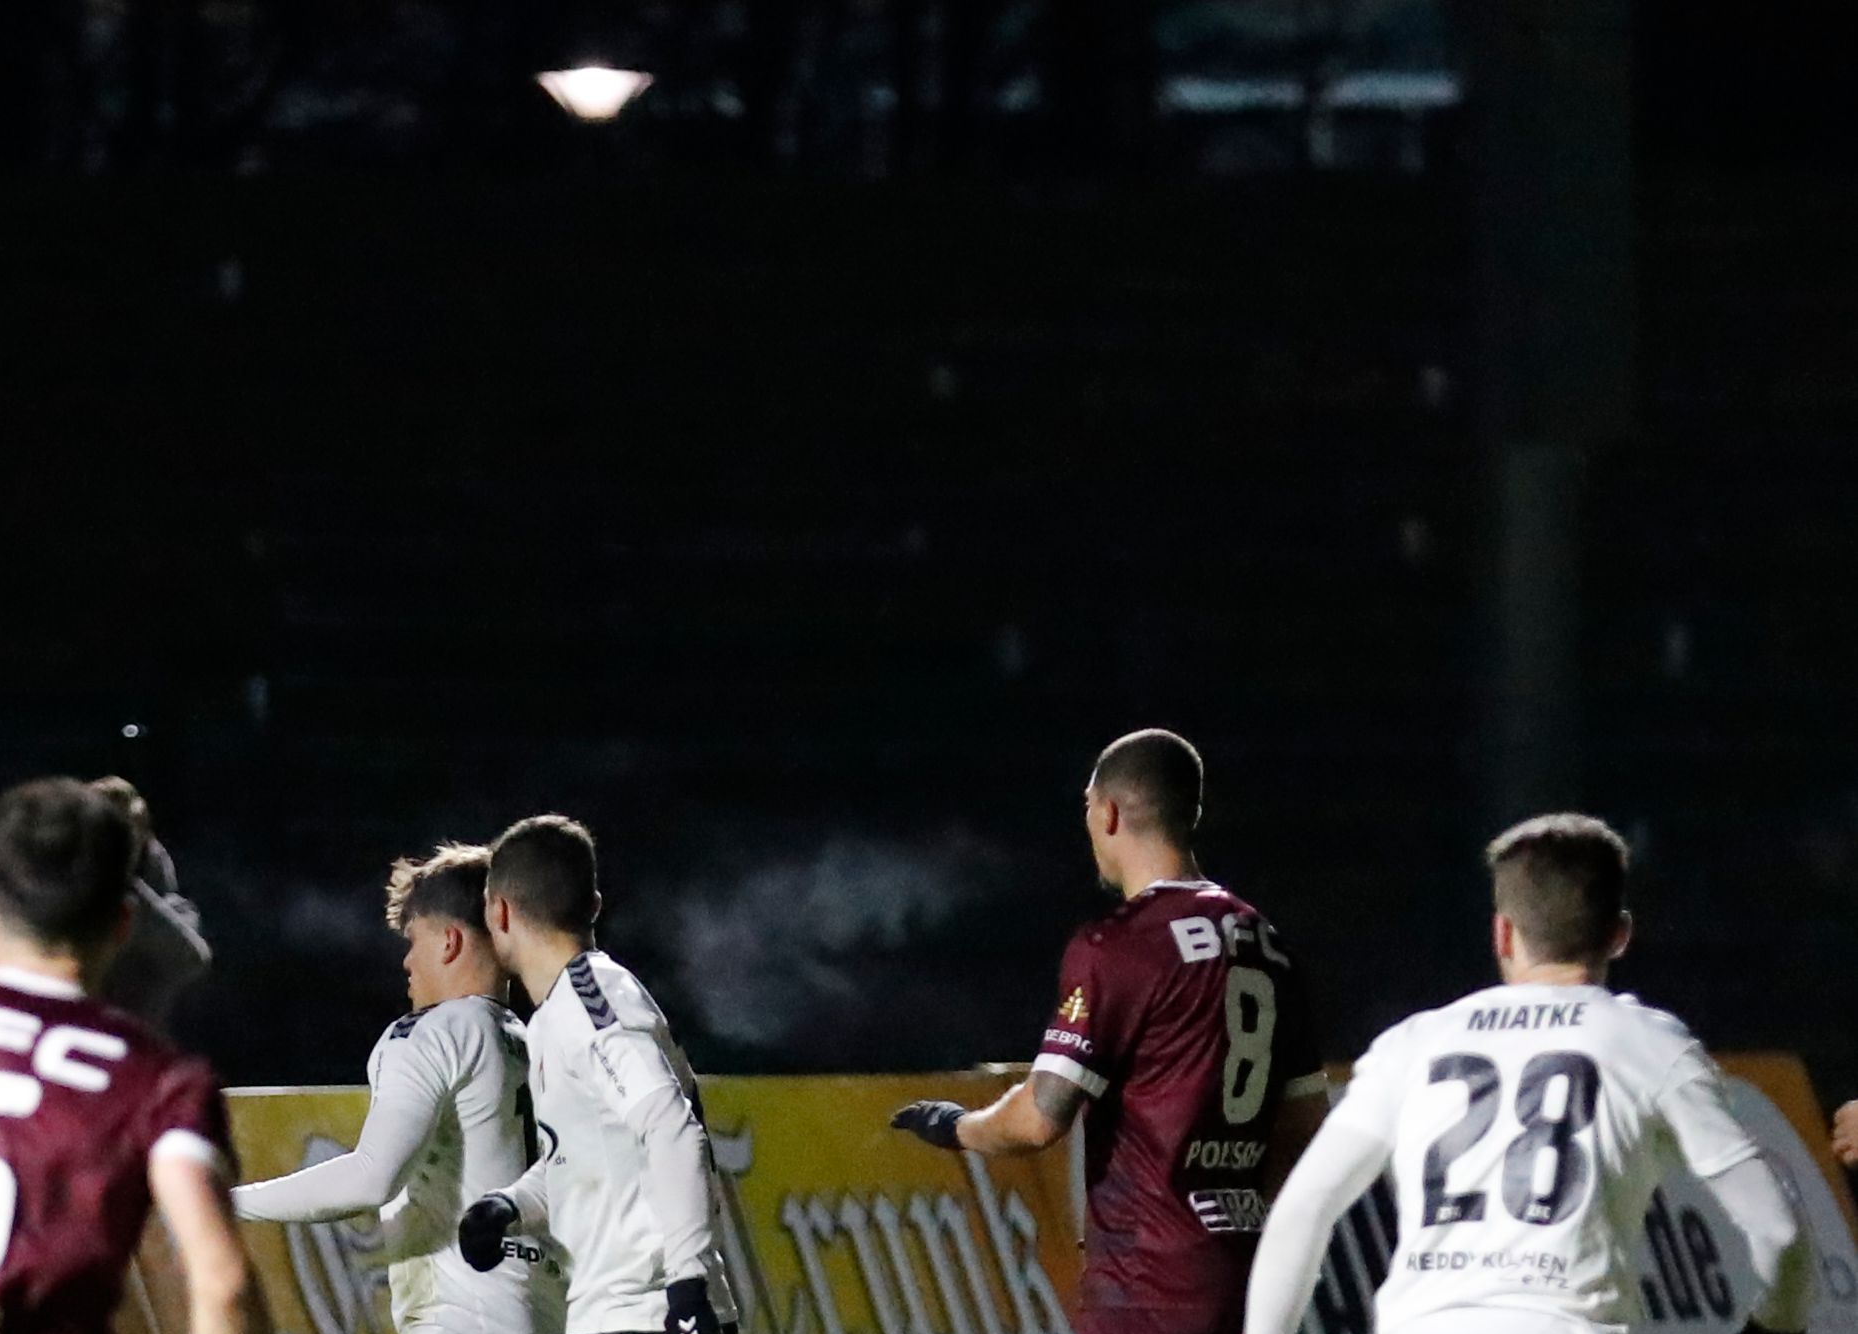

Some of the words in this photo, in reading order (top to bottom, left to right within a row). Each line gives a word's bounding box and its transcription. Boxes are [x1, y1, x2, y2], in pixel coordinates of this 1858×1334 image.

[1222, 965, 1277, 1125] 8
[1467, 1002, 1589, 1031] MIATKE
[1421, 1050, 1602, 1227] 28
